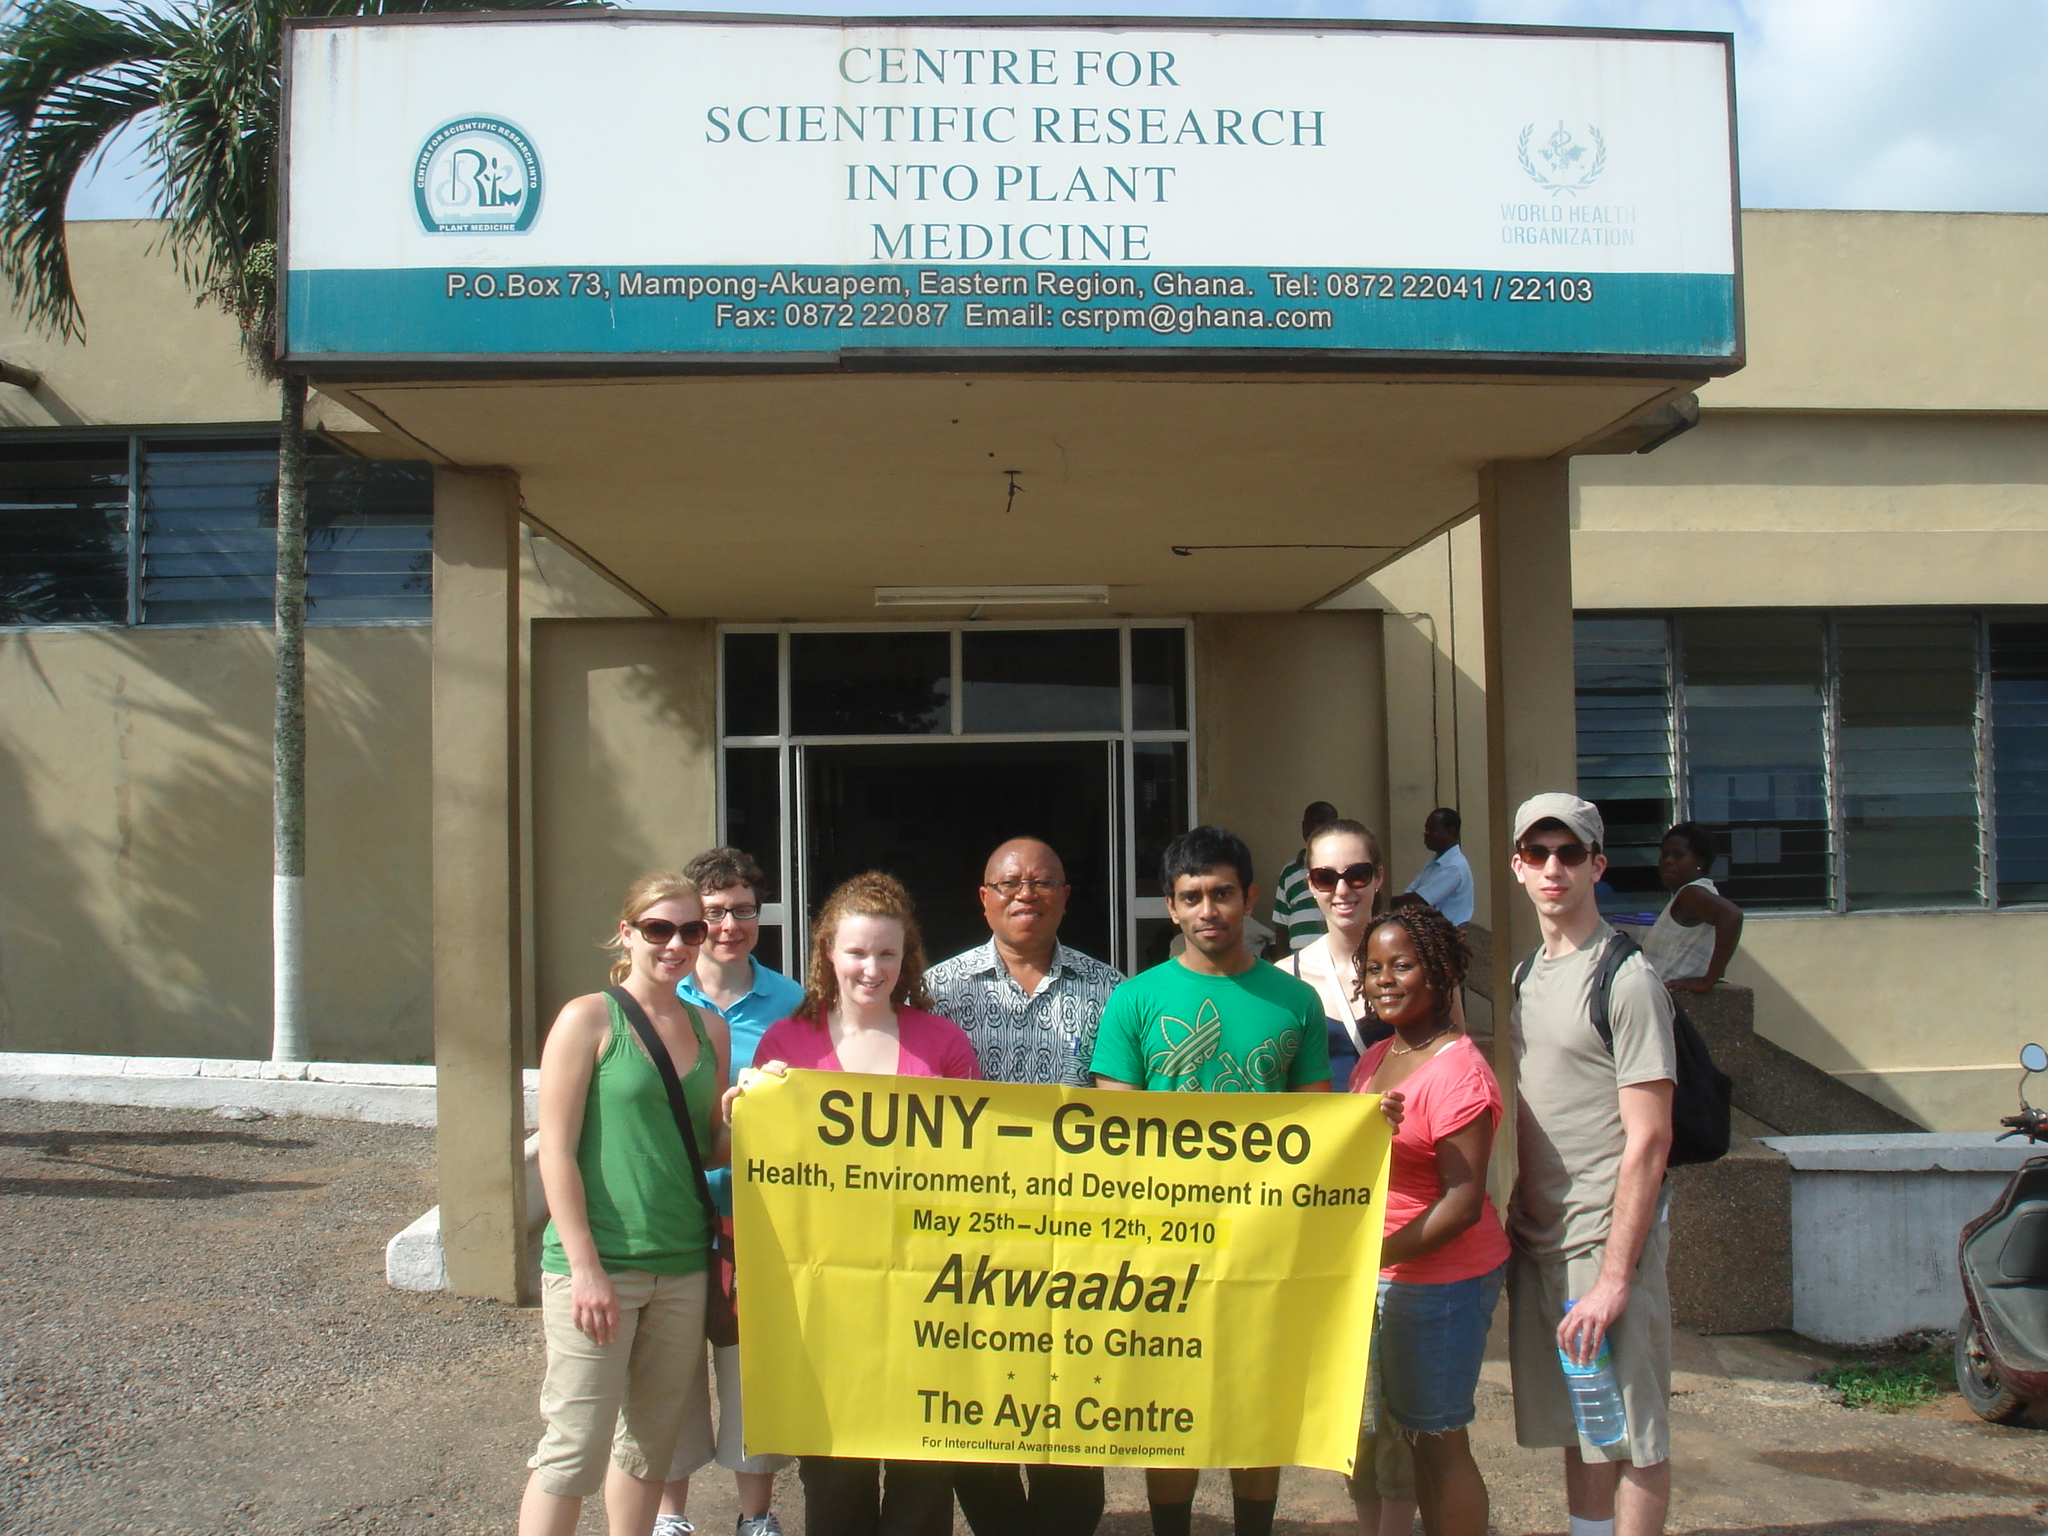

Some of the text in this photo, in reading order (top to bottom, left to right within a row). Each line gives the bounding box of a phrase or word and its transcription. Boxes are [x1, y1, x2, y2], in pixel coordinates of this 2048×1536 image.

[839, 47, 1181, 87] CENTRE FOR
[705, 105, 1327, 147] SCIENTIFIC RESEARCH
[417, 151, 431, 189] CENTRE
[427, 134, 444, 152] FOR
[445, 121, 497, 137] SCIENTIFIC
[497, 126, 533, 164] RESEARCH
[528, 165, 538, 189] INTO
[844, 164, 1176, 202] INTO PLANT
[1500, 203, 1636, 224] WORLD HEALTH
[870, 223, 1151, 261] MEDICINE
[1501, 226, 1635, 246] ORGANIZATION
[446, 271, 1594, 302] P.O.Box 73, Mampong-Akuapem, Eastern Region, Ghana. Tel: 0872 22041 / 22103
[715, 303, 1334, 333] Fax: 0872 22087 Email: csrpm@ghana.com
[1052, 1102, 1311, 1165] Geneseo
[747, 1158, 1371, 1208] Health, Environment, and Development in Ghana
[912, 1209, 961, 1237] May
[1101, 1217, 1152, 1244] 12th,
[1160, 1220, 1216, 1244] 2010
[923, 1253, 1201, 1314] Akwaaba!
[913, 1320, 1203, 1359] Welcome to Ghana
[917, 1389, 1195, 1437] The Aya Centre
[922, 1436, 1185, 1458] For Intercultural Awareness and Development
